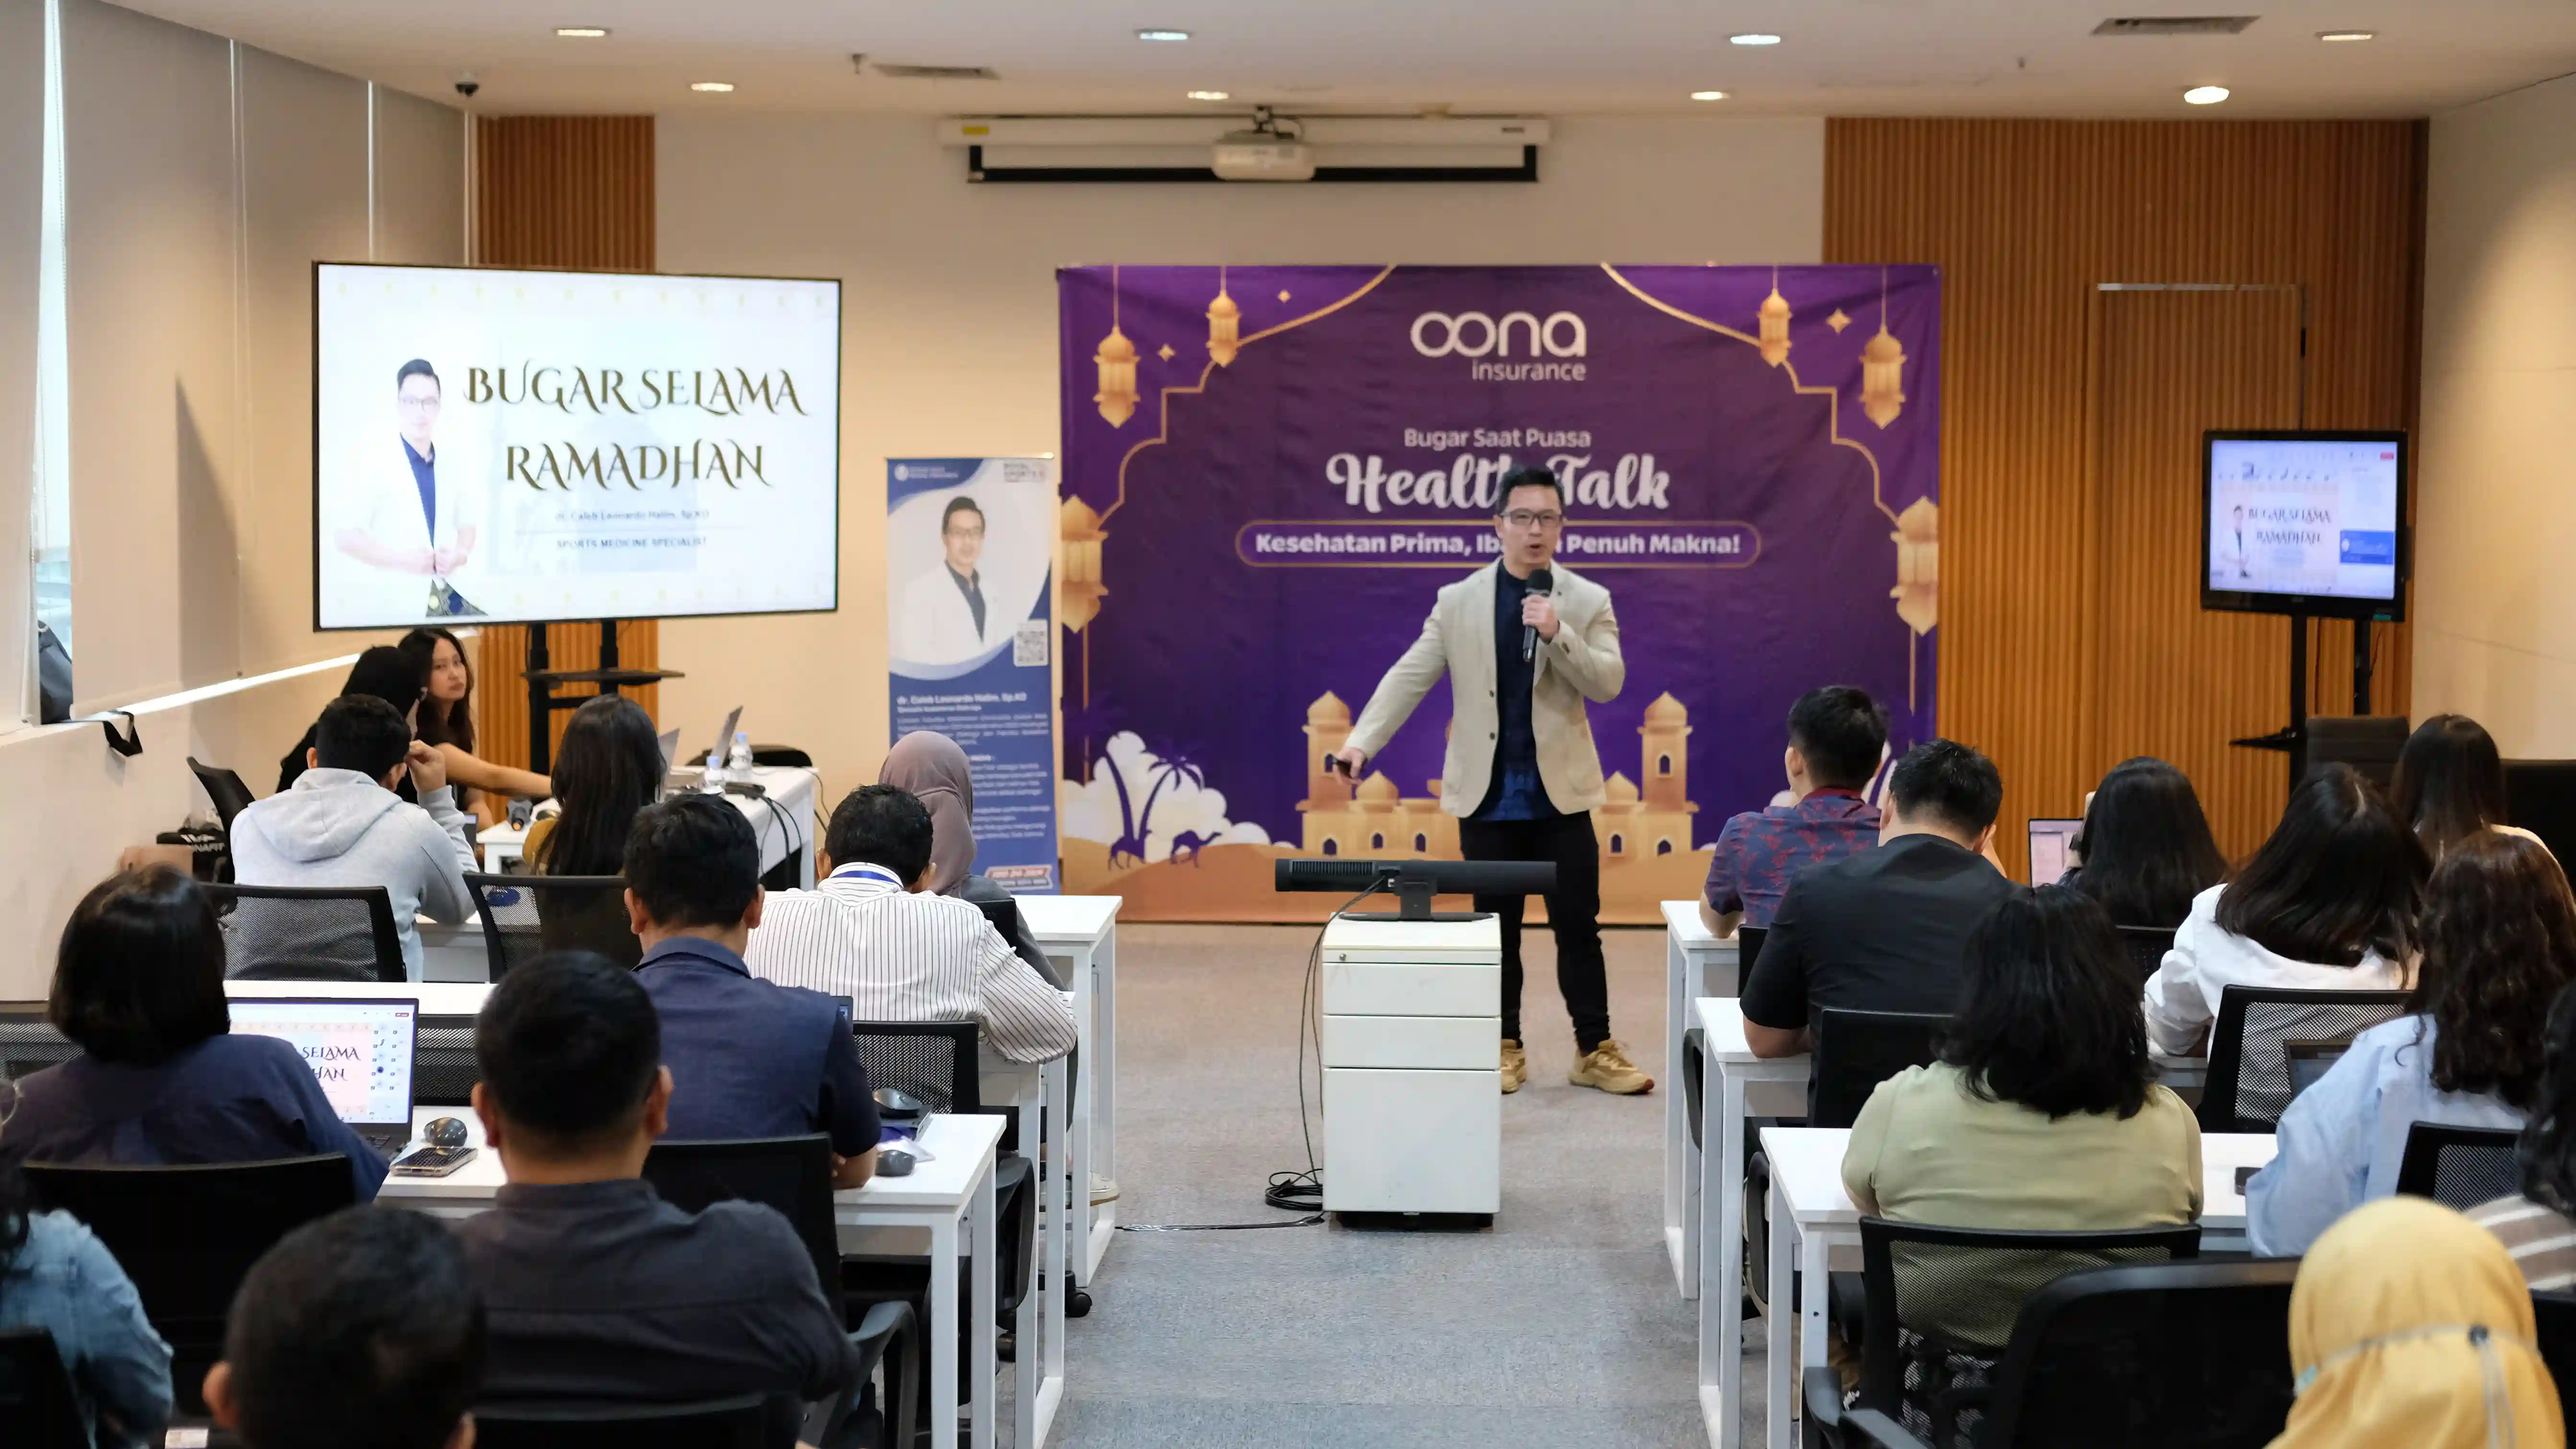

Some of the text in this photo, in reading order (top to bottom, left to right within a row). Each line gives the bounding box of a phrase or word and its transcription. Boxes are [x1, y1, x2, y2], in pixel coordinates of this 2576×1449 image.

[1409, 311, 1586, 357] oona
[1472, 358, 1587, 381] insurance
[463, 359, 808, 416] BUGAR SELAMA
[1404, 428, 1592, 451] Bugar Saat Puasa
[506, 438, 774, 491] RAMADHAN
[1325, 452, 1671, 513] Healt Talk
[1255, 533, 1386, 553] Kesehatan
[1391, 532, 1472, 557] Prima,
[1567, 533, 1645, 554] Penuh
[1650, 533, 1741, 554] Makna!
[302, 1046, 361, 1060] SELAMA
